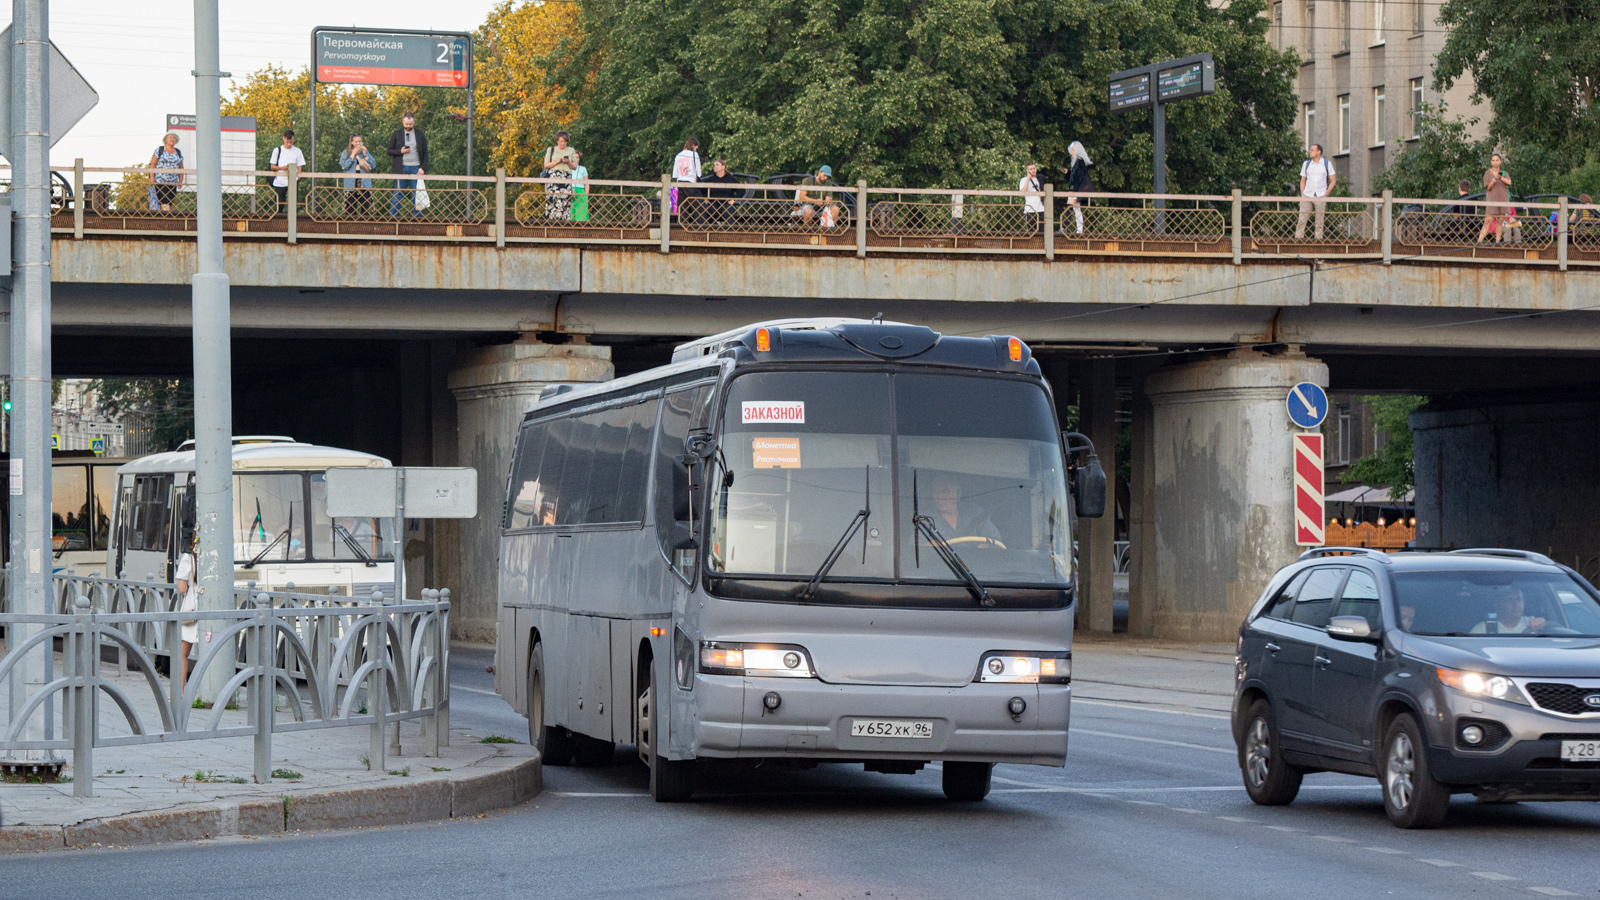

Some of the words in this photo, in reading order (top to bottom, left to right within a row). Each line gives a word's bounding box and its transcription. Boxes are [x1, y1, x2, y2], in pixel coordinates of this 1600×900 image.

[323, 36, 403, 50] Первомайская
[323, 51, 386, 62] Pervomayskaya
[436, 43, 449, 63] 2
[744, 404, 803, 420] ЗАКАЗНОЙ
[915, 723, 927, 733] 96
